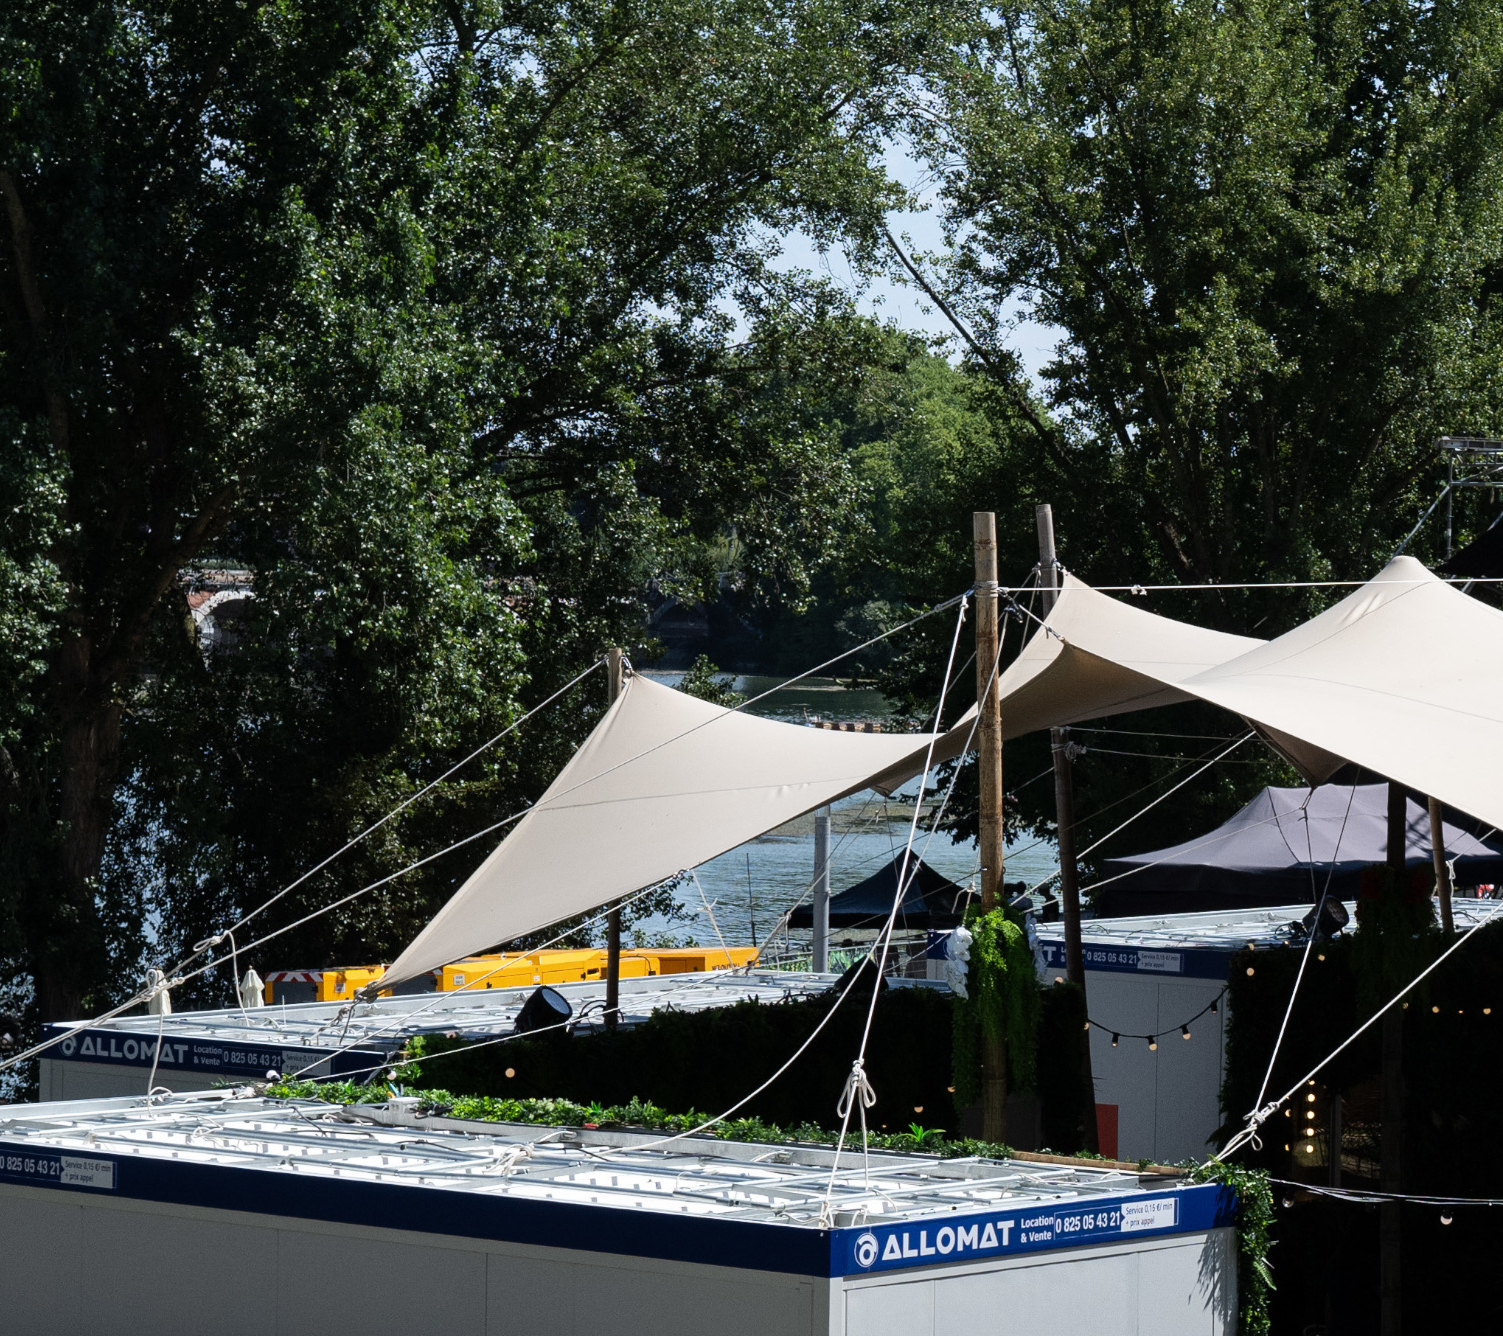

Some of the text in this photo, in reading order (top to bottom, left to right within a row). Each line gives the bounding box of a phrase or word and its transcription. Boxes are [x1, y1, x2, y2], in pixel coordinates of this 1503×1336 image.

[1086, 953, 1092, 961] 0
[1093, 953, 1107, 962] 825
[1107, 953, 1117, 963] 05
[1118, 954, 1128, 964] 43
[1129, 954, 1137, 964] 21
[80, 1036, 189, 1064] ALLOMAT
[193, 1044, 223, 1056] Location
[223, 1050, 229, 1063] 0
[230, 1051, 246, 1064] 825
[247, 1052, 258, 1065] 05
[259, 1053, 270, 1066] 43
[271, 1055, 282, 1067] 21
[200, 1056, 221, 1066] Vente
[6, 1157, 23, 1172] 825
[24, 1159, 36, 1173] 05
[37, 1160, 48, 1174] 43
[49, 1161, 60, 1176] 21
[881, 1219, 1015, 1262] ALLOMAT
[1020, 1215, 1054, 1229] Location
[1055, 1218, 1062, 1234] 0
[1063, 1216, 1081, 1233] 825
[1082, 1214, 1095, 1231] 05
[1096, 1212, 1108, 1228] 43
[1109, 1210, 1120, 1227] 21
[1020, 1233, 1028, 1244] &
[1028, 1230, 1052, 1243] Vente
